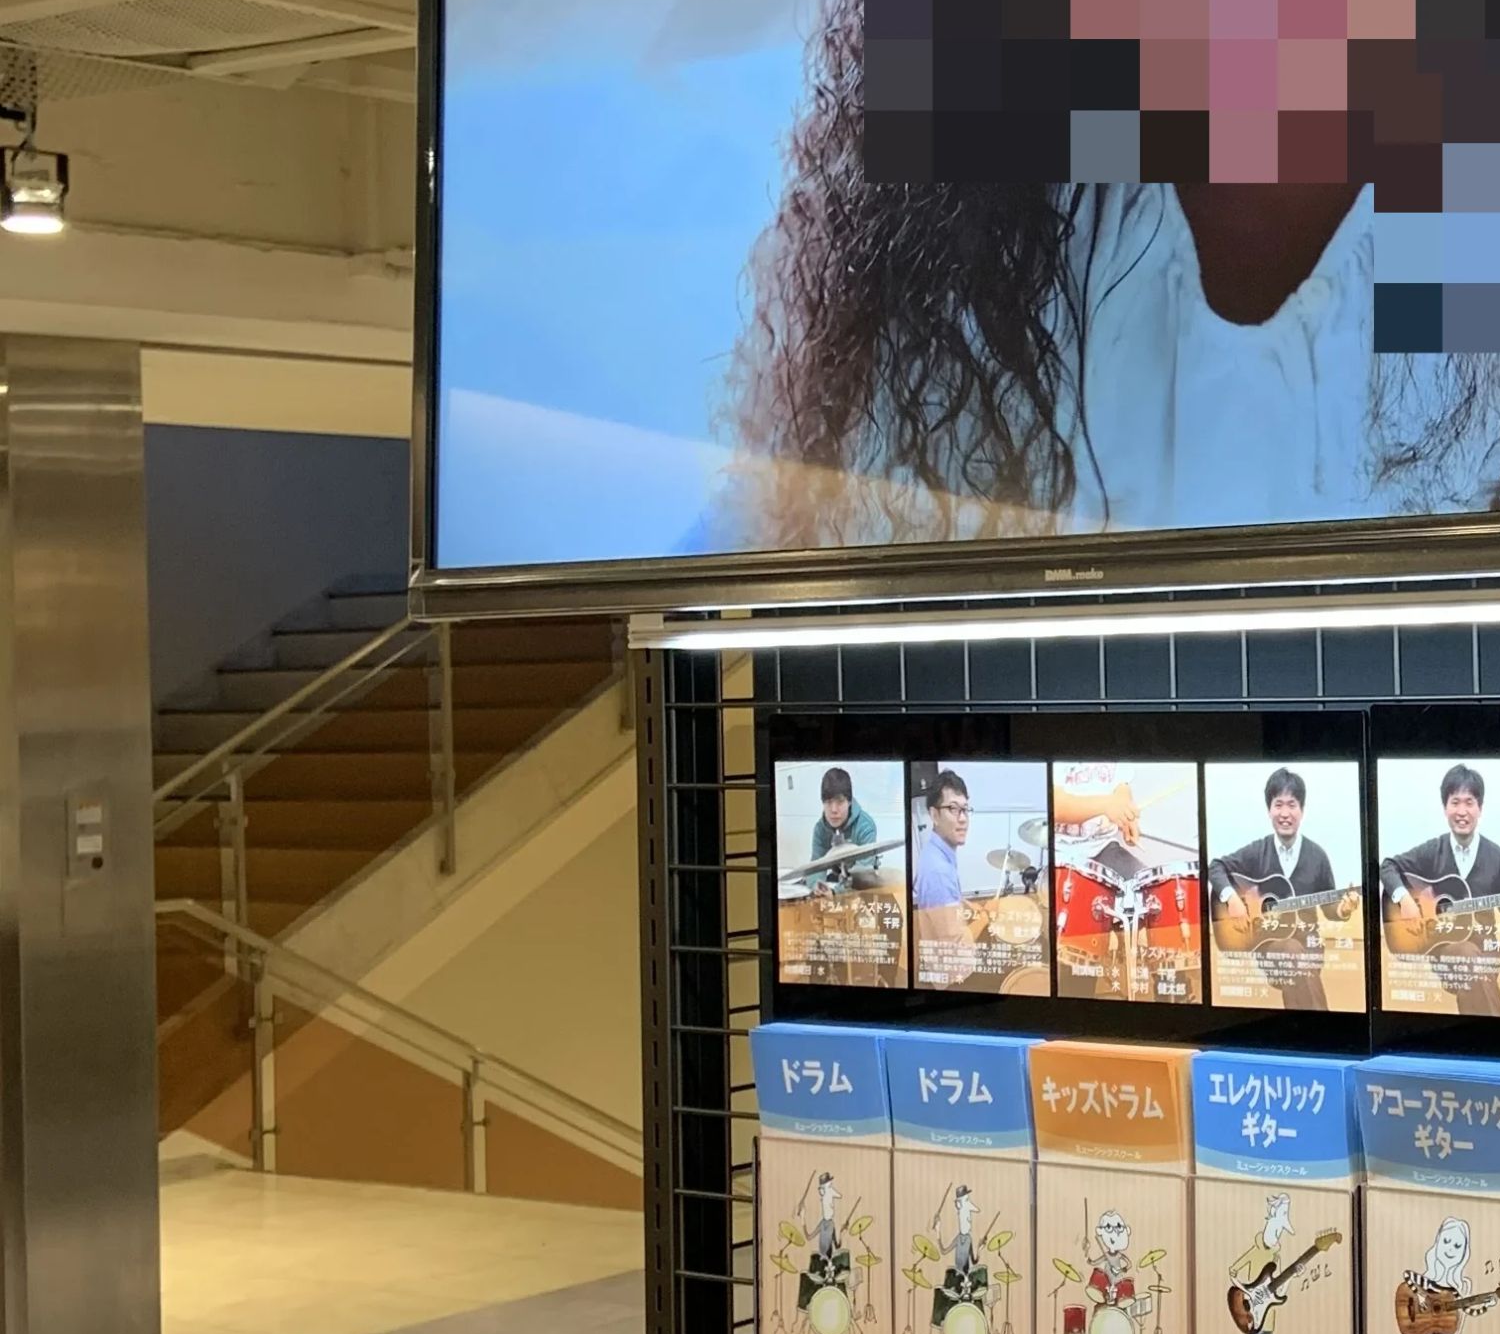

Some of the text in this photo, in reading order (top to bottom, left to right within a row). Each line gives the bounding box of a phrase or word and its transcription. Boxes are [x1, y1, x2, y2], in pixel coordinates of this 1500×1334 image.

[782, 1058, 853, 1095] ドラム
[918, 1067, 993, 1106] ドラム
[1208, 1073, 1326, 1115] エレクトリック
[1041, 1075, 1164, 1120] キッズドラム
[1241, 1112, 1297, 1148] ギター
[1414, 1124, 1474, 1159] ギター
